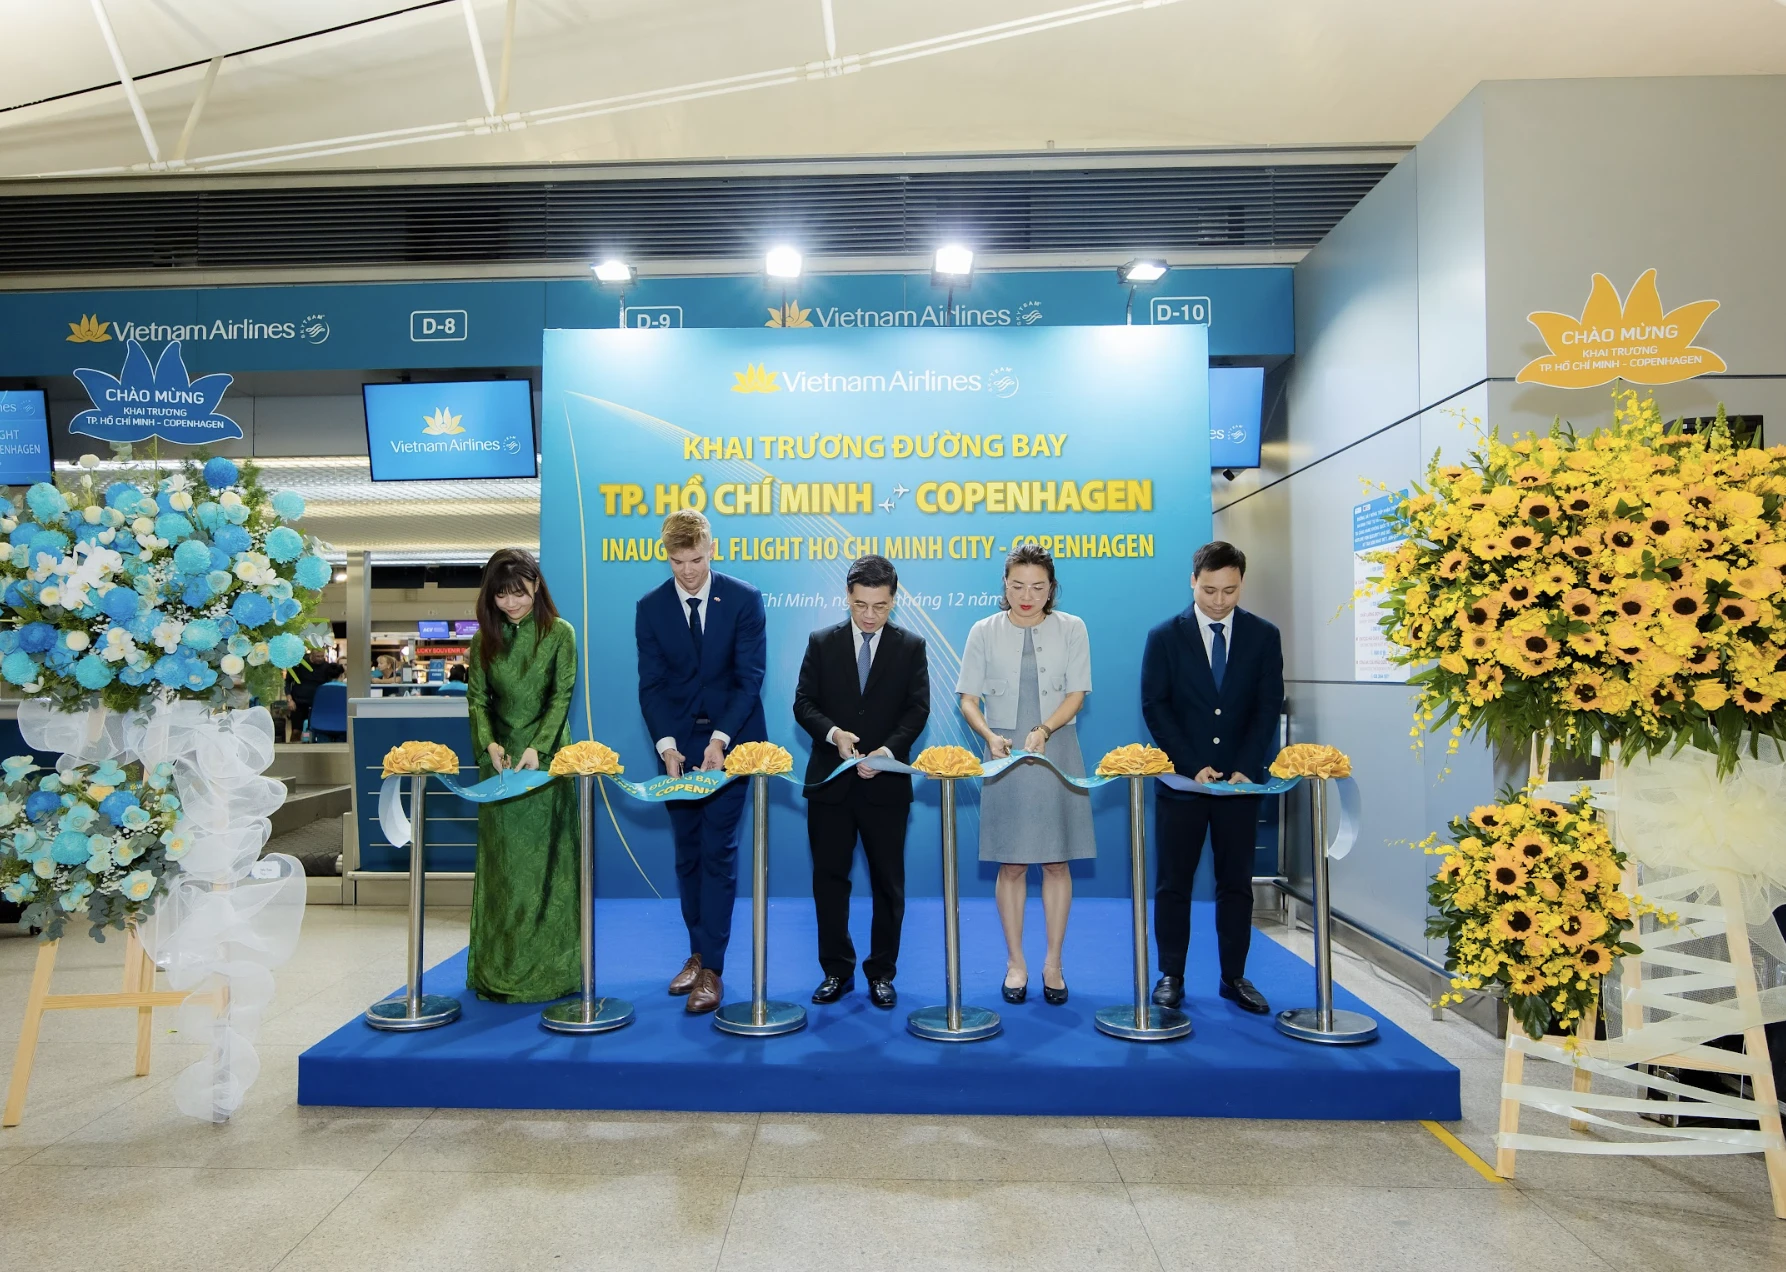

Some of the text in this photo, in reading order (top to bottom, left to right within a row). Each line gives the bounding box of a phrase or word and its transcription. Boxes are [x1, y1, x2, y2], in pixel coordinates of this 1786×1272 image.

[637, 313, 671, 329] D-9
[815, 305, 1011, 327] Vietnam Airlines
[1157, 304, 1205, 321] D-10
[112, 318, 296, 342] Vietnam Airlines
[422, 317, 456, 335] D-8
[1561, 322, 1679, 345] CHÀO MỪNG
[1582, 345, 1658, 358] KHAI TRƯƠNG
[1539, 363, 1552, 372] TP.
[1572, 359, 1590, 371] CHÍ
[1592, 360, 1620, 370] MINH
[1629, 355, 1703, 367] COPENHAGEN
[781, 369, 982, 393] Vietnam Airlines
[105, 386, 205, 404] CHÀO MỪNG
[123, 407, 187, 417] KHAI TRƯƠNG
[86, 416, 98, 425] TP.
[115, 416, 131, 426] CHÍ
[132, 417, 155, 427] MINH
[163, 418, 224, 429] COPENHAGEN
[0, 429, 19, 440] GHT
[0, 444, 41, 454] ENHAGEN
[390, 440, 448, 453] Vietnam
[449, 438, 500, 451] Airlines
[683, 430, 1068, 460] KHAI TRƯƠNG ĐƯỜNG BAY
[599, 473, 1154, 516] TP. HỒ CHÍ MINH COPENHAGEN
[602, 537, 725, 562] INAUGL
[729, 537, 803, 561] FLIGHT
[808, 537, 839, 560] HO
[843, 536, 878, 560] CHI
[884, 536, 943, 560] MINH
[948, 535, 995, 559] CITY
[784, 592, 828, 609] Minh,
[895, 591, 942, 611] tháng
[947, 592, 965, 607] 12
[967, 591, 1003, 607] năm
[696, 775, 719, 786] BAY
[655, 783, 717, 797] COPENH
